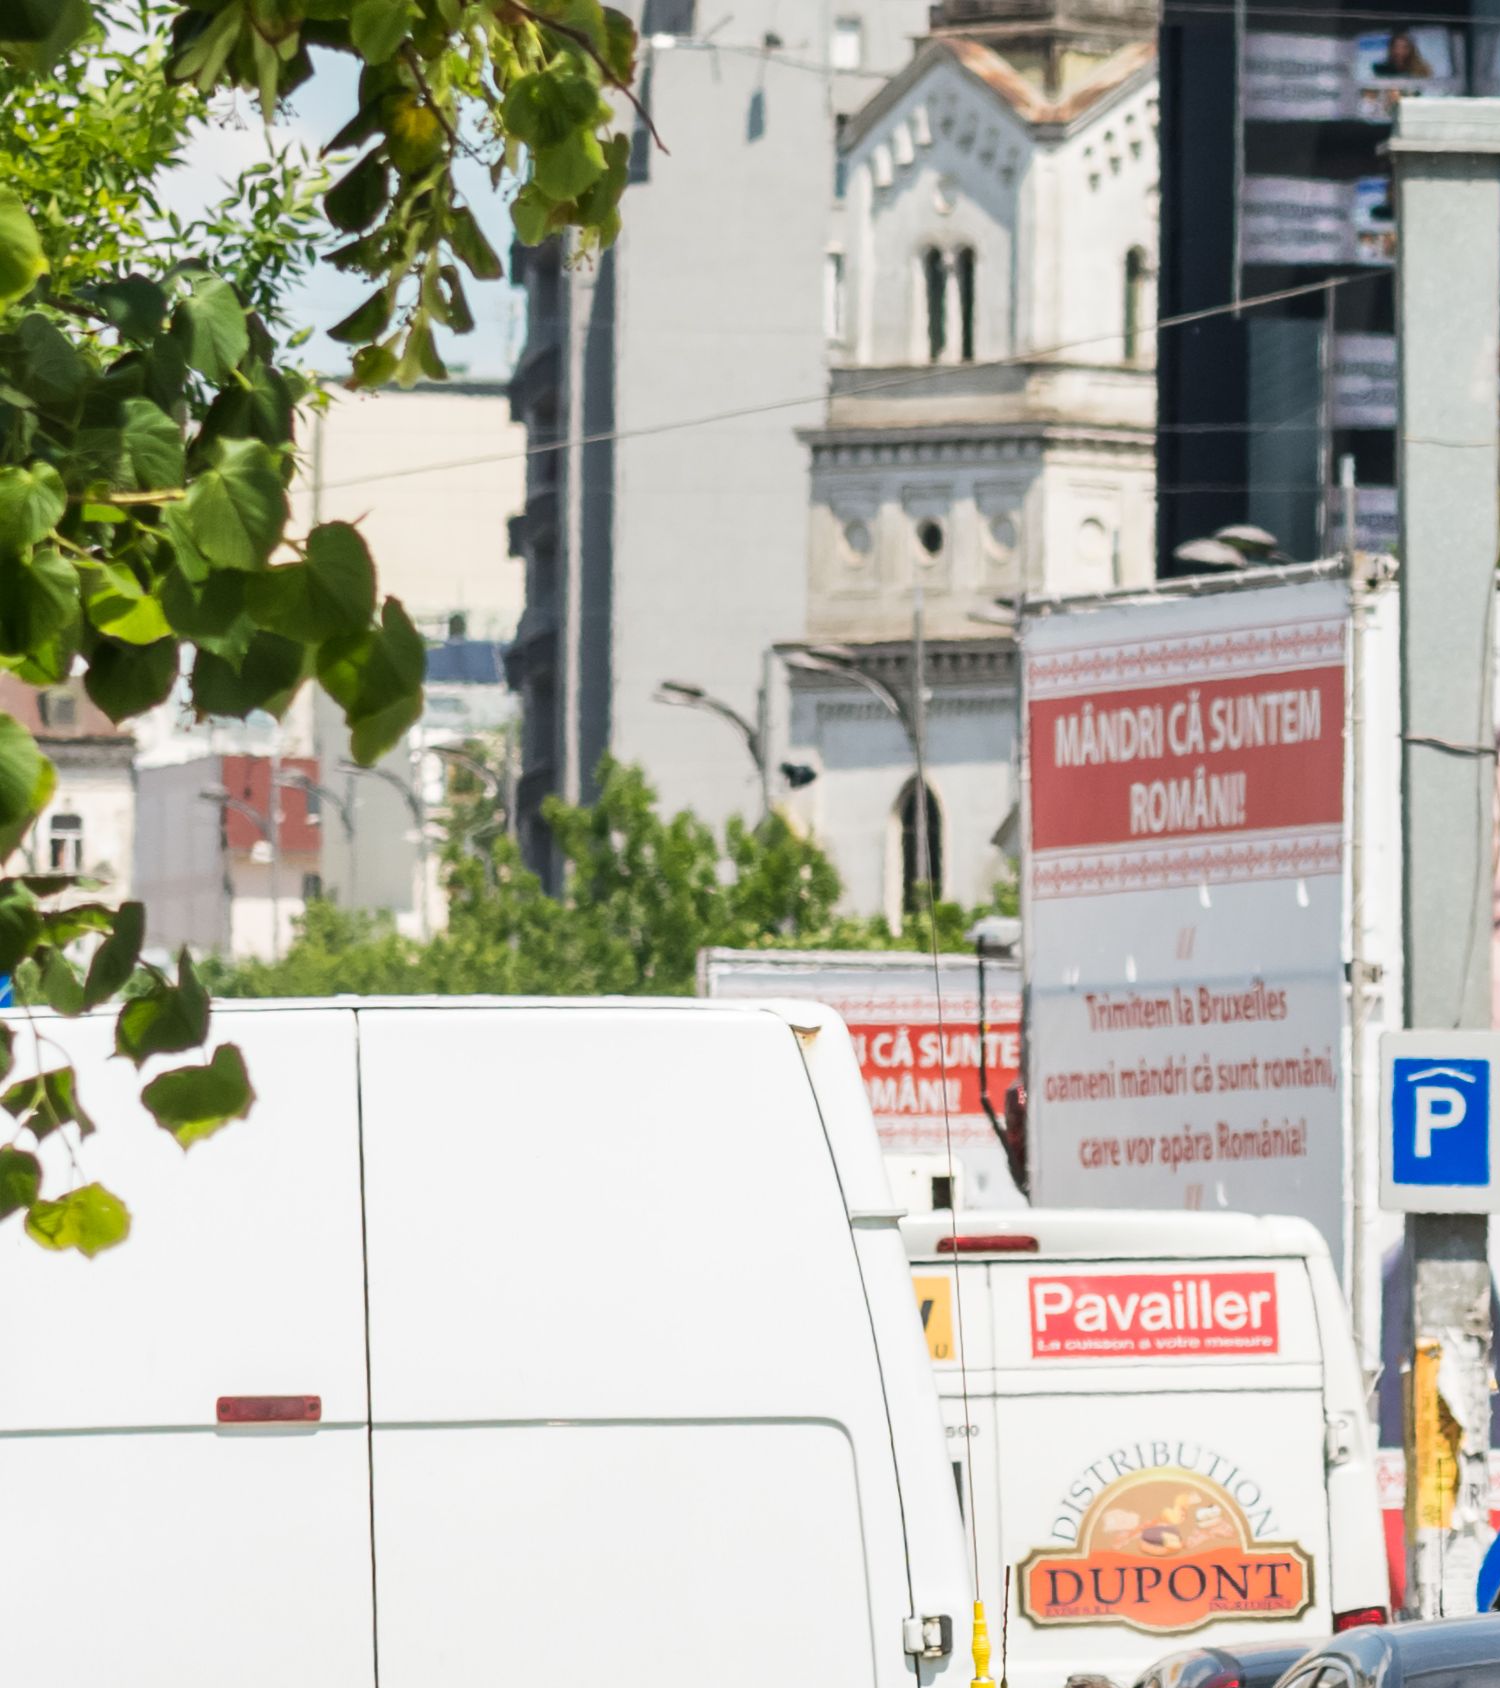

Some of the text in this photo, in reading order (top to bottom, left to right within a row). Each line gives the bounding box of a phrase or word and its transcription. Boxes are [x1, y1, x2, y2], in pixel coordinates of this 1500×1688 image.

[1054, 688, 1322, 768] MÂNDRI CĂ SUNTEM
[1130, 765, 1247, 836] ROMÂNI!
[1085, 977, 1288, 1033] Trimitem la Bruxelles
[871, 1026, 914, 1068] CĂ
[918, 1031, 1021, 1069] SUNTE
[864, 1071, 962, 1113] MÂNI!
[1044, 1069, 1115, 1104] oameni
[1120, 1060, 1187, 1100] mândri
[1190, 1058, 1213, 1094] că
[1216, 1056, 1260, 1091] sunt
[1079, 1117, 1307, 1174] care vor apăra România!
[1033, 1280, 1272, 1333] Pavailler
[1050, 1440, 1279, 1542] DISTRIBUTION
[1043, 1562, 1292, 1607] DUPONT
